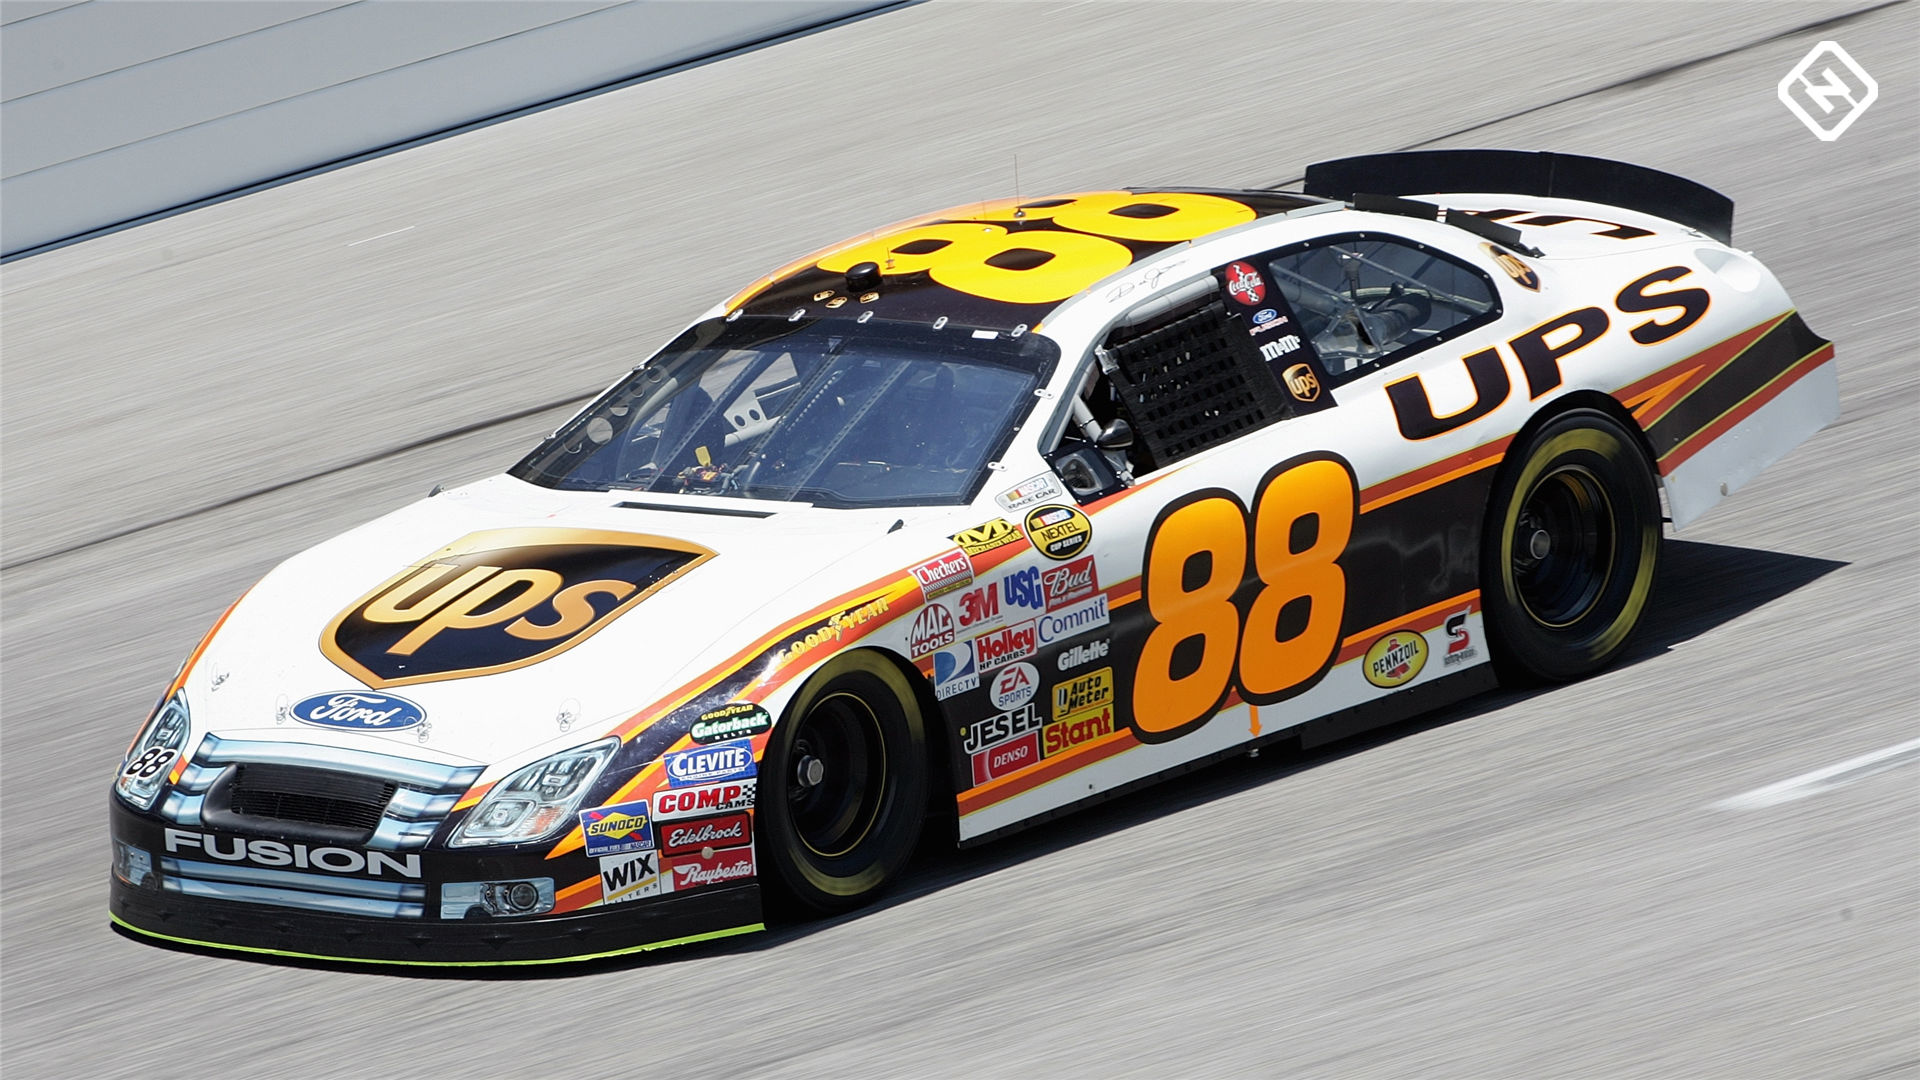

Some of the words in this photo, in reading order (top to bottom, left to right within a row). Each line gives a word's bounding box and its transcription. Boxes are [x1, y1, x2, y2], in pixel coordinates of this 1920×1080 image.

[816, 190, 1257, 304] 88
[1384, 265, 1711, 440] UPS
[1294, 373, 1317, 397] ups
[1035, 488, 1056, 499] CAR
[1040, 521, 1081, 542] NEXTEL
[916, 557, 967, 585] Checkers
[1043, 560, 1093, 597] Bud
[1004, 566, 1043, 609] USG
[1131, 450, 1360, 745] 88
[361, 564, 637, 655] ups
[959, 582, 999, 627] 3M
[777, 598, 889, 662] GOODYEAR
[912, 605, 953, 644] MAC
[1038, 599, 1106, 643] Commit
[911, 631, 955, 657] TOOLS
[979, 626, 1035, 663] Holley
[1057, 642, 1109, 671] Gillette
[979, 660, 993, 671] HP
[994, 650, 1026, 666] CARBS
[1372, 640, 1420, 678] PENNZOIL
[936, 677, 978, 699] DIRECTV
[1000, 666, 1030, 694] EA
[1070, 676, 1102, 696] Auto
[310, 693, 402, 725] Ford
[998, 687, 1032, 707] SPORTS
[1068, 687, 1109, 709] Meter
[691, 712, 768, 739] Gatorback
[701, 704, 754, 721] GOODYEAR
[967, 706, 1042, 750] JESEL
[1045, 707, 1112, 754] Stant
[125, 747, 178, 779] 88
[672, 748, 745, 776] CLEVITE
[994, 746, 1028, 768] DENSO
[659, 785, 742, 813] COMP
[716, 799, 755, 811] CAMS
[590, 817, 644, 834] SUNOCO
[668, 821, 743, 848] Edelbrock
[164, 828, 422, 878] FUSION
[603, 852, 655, 891] WIX
[673, 860, 752, 885] Raybestos
